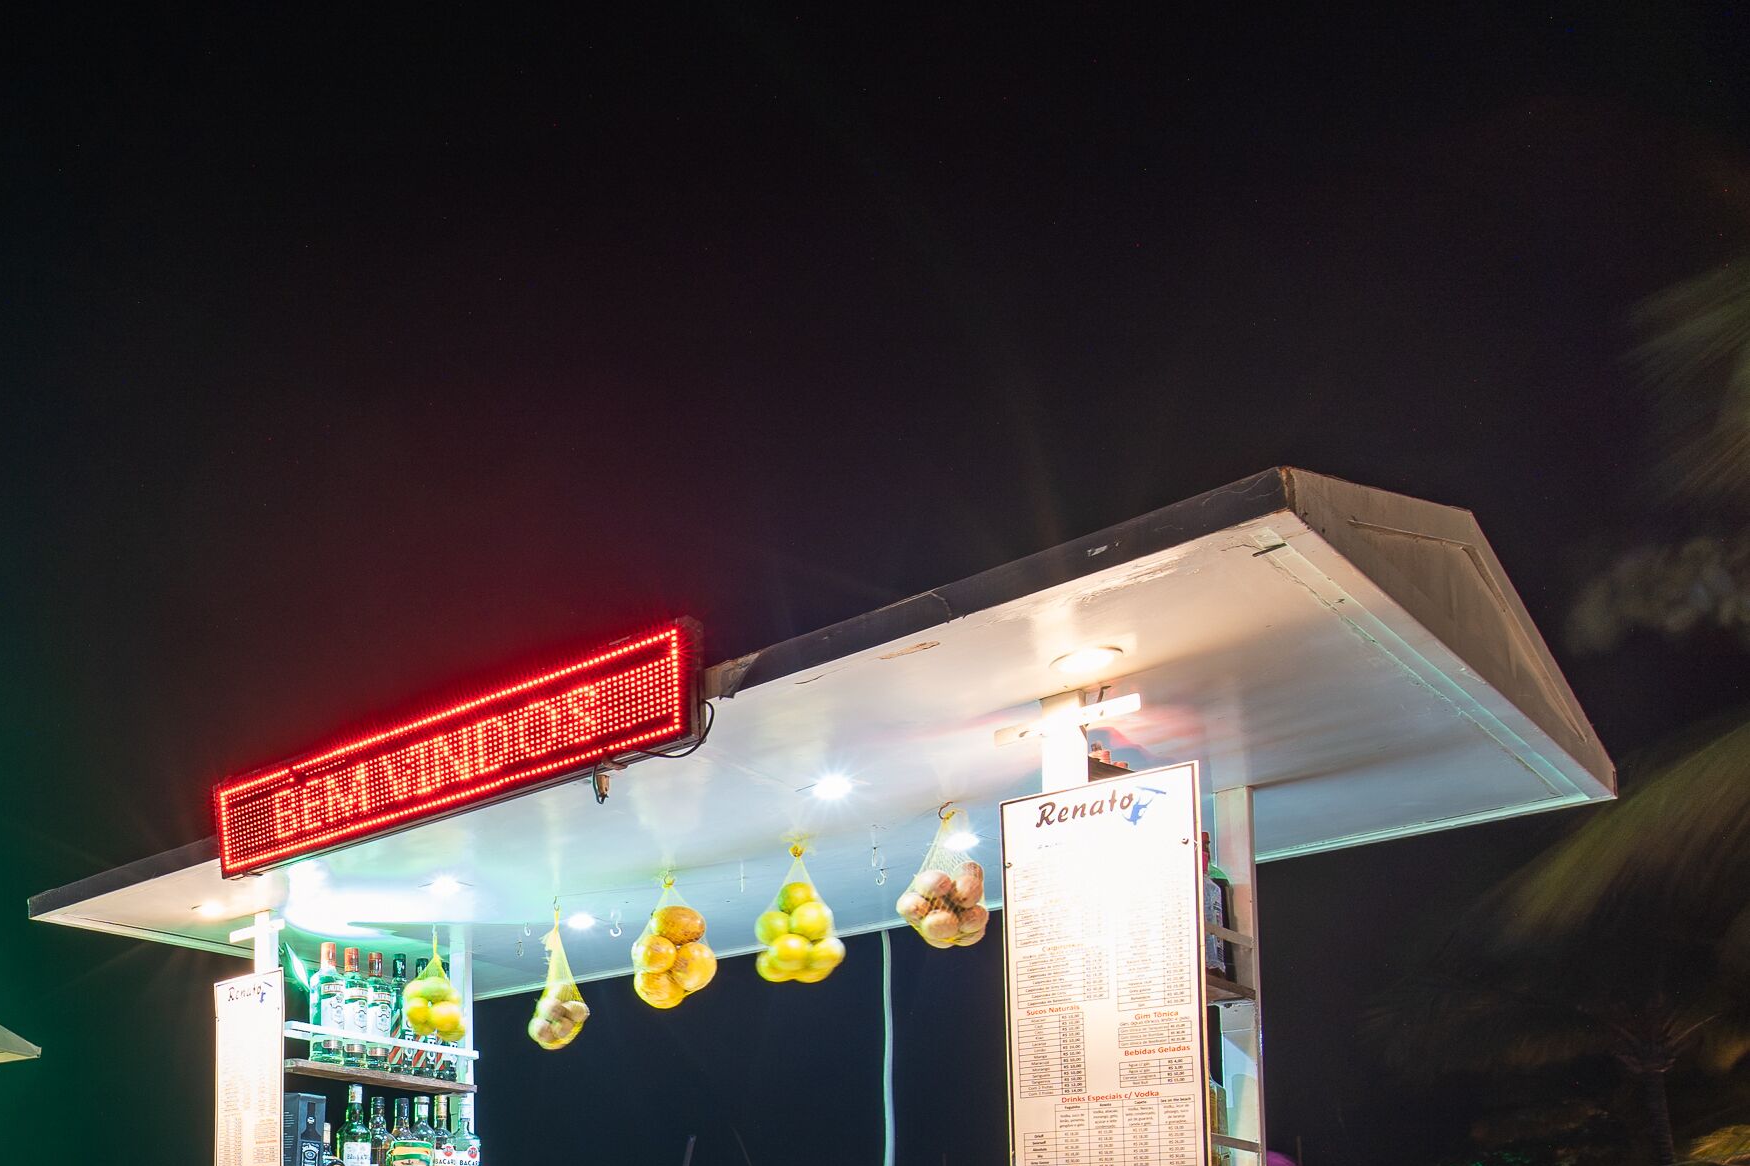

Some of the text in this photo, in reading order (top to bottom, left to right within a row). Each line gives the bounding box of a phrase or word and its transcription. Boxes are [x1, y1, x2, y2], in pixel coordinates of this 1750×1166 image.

[273, 760, 369, 839] BEM
[1036, 789, 1134, 828] Renato
[1061, 1096, 1086, 1104] Drinks
[1088, 1093, 1122, 1103] Especiais
[1134, 1090, 1160, 1098] Vodka
